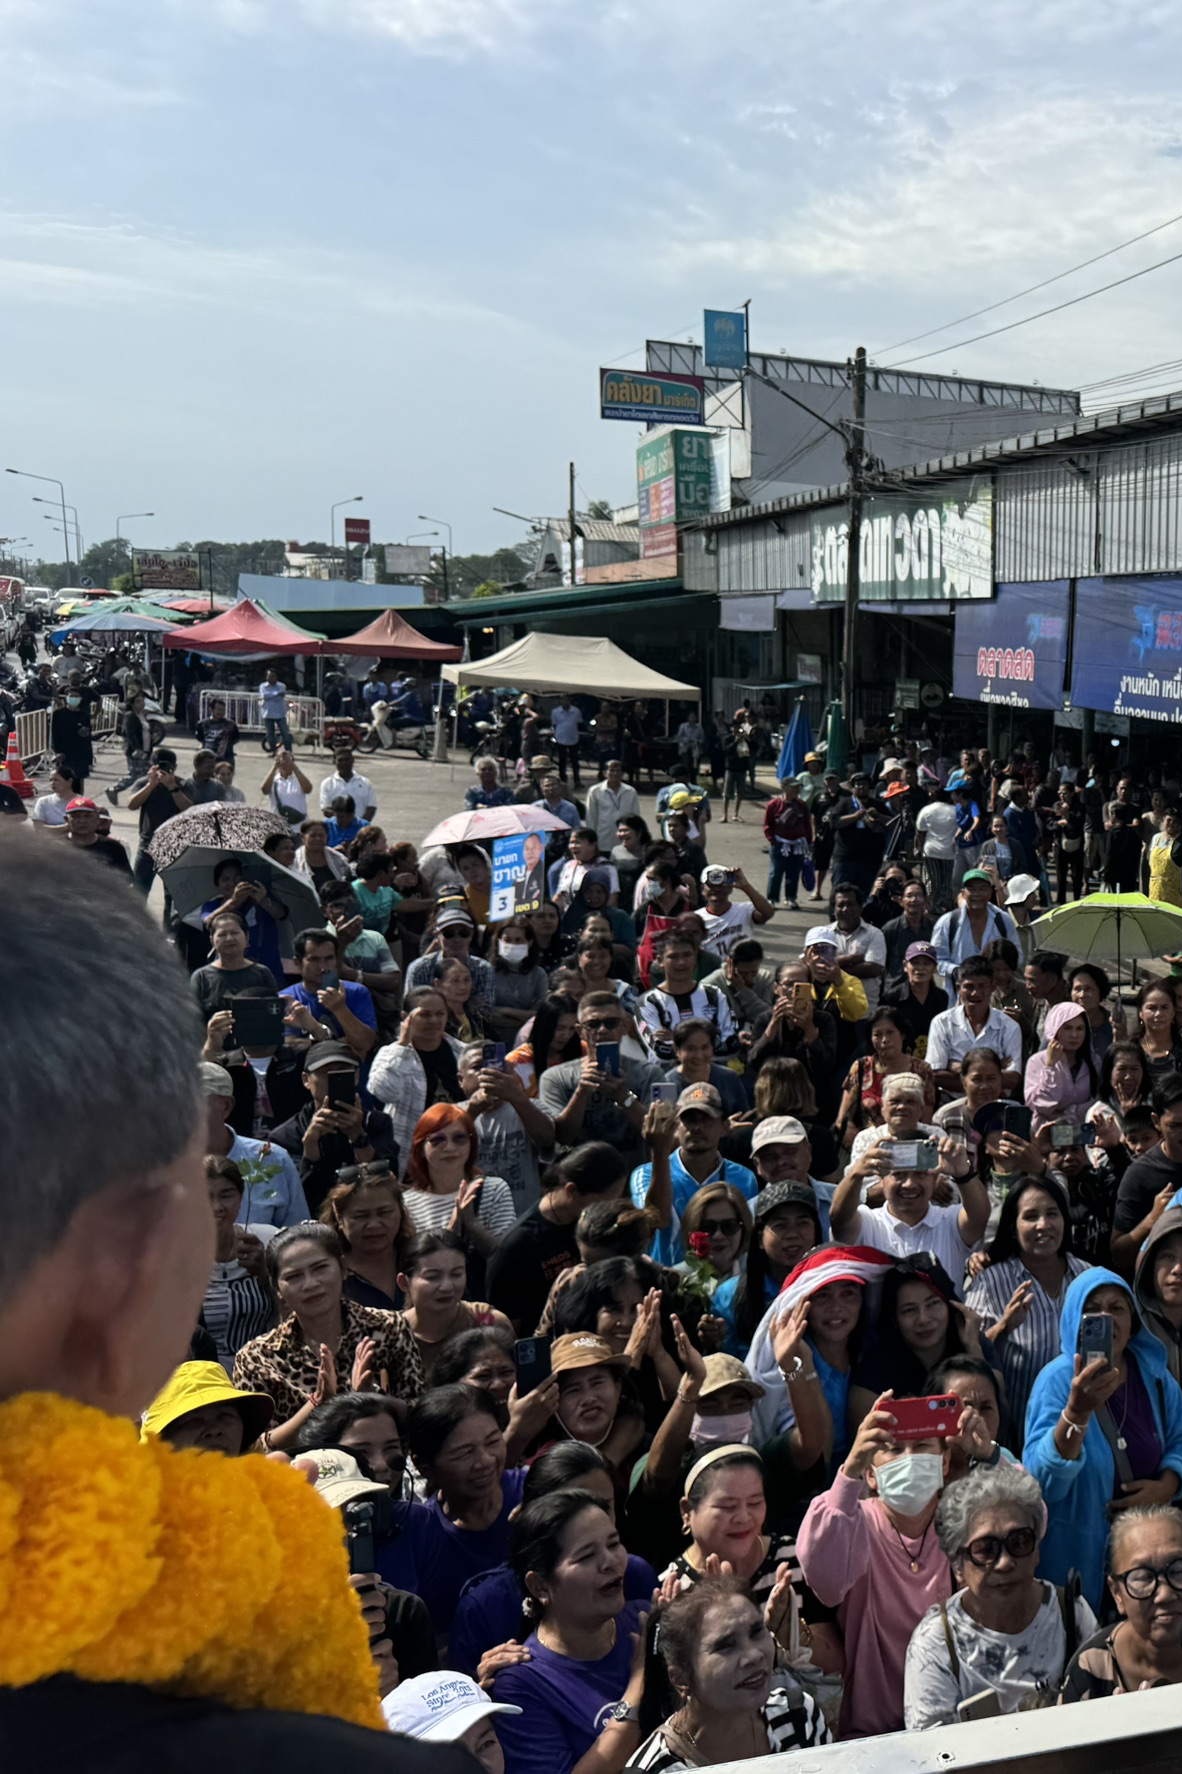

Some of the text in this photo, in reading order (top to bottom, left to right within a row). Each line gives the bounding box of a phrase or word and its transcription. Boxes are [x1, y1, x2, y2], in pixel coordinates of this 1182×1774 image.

[606, 376, 662, 406] คลังยา
[977, 646, 1035, 682] ตลาดสด
[1120, 671, 1160, 697] งานหนัก
[494, 853, 518, 866] นายก
[493, 865, 526, 883] ชาญ
[498, 896, 508, 911] 3
